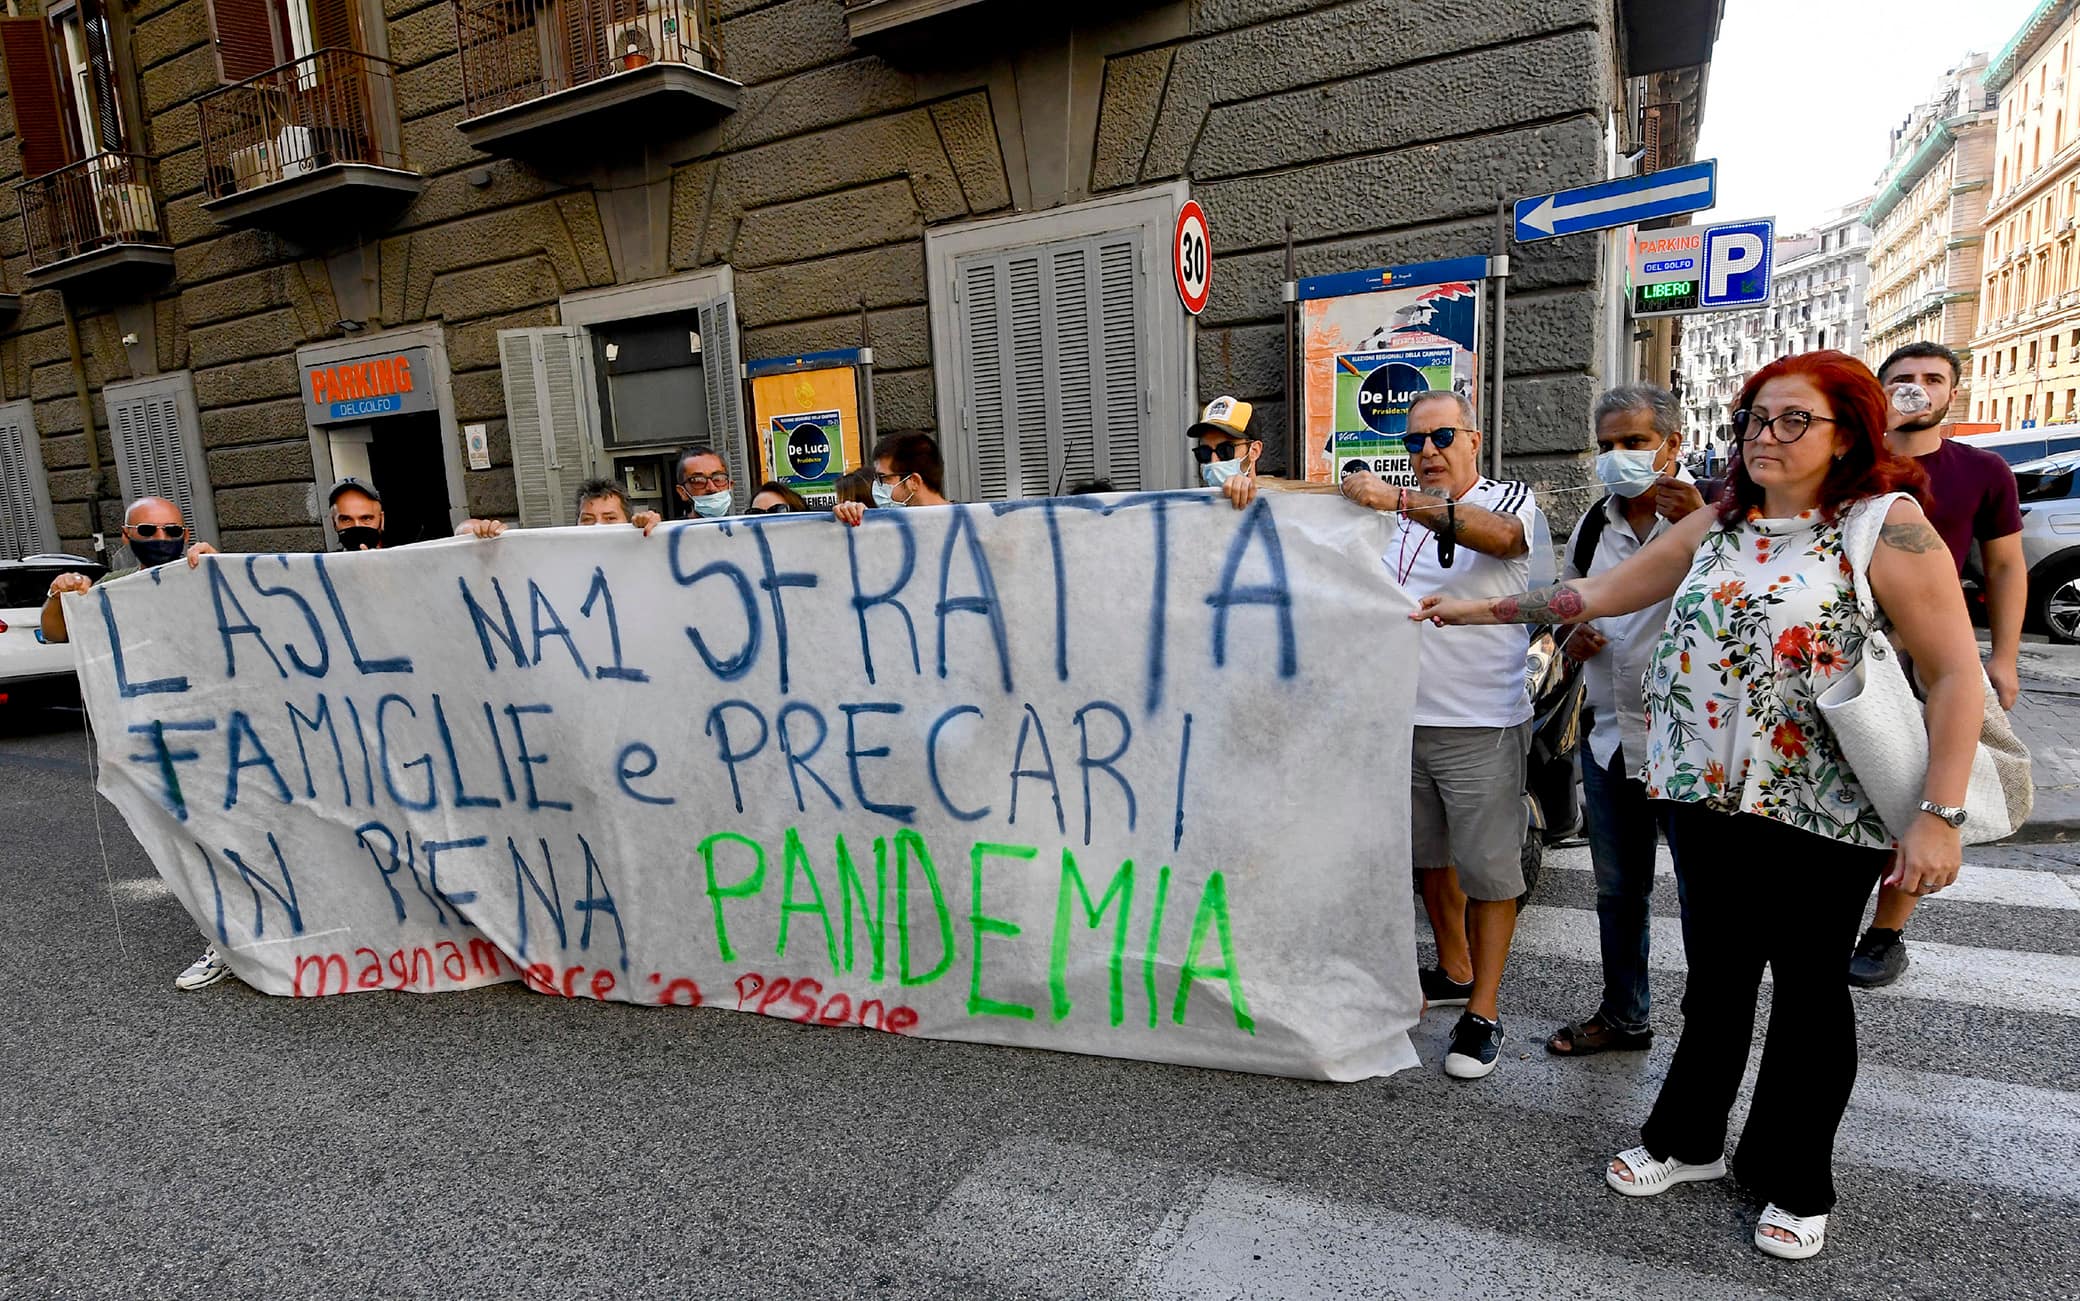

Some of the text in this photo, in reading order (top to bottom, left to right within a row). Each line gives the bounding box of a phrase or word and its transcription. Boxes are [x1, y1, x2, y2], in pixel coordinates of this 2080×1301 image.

[1639, 235, 1700, 254] PARKING
[1183, 231, 1204, 285] 30
[1646, 260, 1691, 272] DEL GOLFO
[1708, 233, 1764, 297] P
[1644, 282, 1691, 299] LIBERO
[1637, 296, 1698, 312] COMPLETO
[1404, 350, 1421, 359] DELLA
[1431, 358, 1450, 366] 20-21
[310, 355, 413, 404] PARKING
[1360, 389, 1420, 404] De Luc
[339, 398, 390, 415] DEL GOLFO
[1372, 407, 1408, 415] President
[788, 444, 829, 455] De Luca
[459, 565, 650, 683] NA1
[668, 492, 1300, 722] SFRATTA
[127, 692, 1194, 851] FAMIGLIE e PRECARI
[194, 821, 1256, 1036] IN PIENA PANDEMIA
